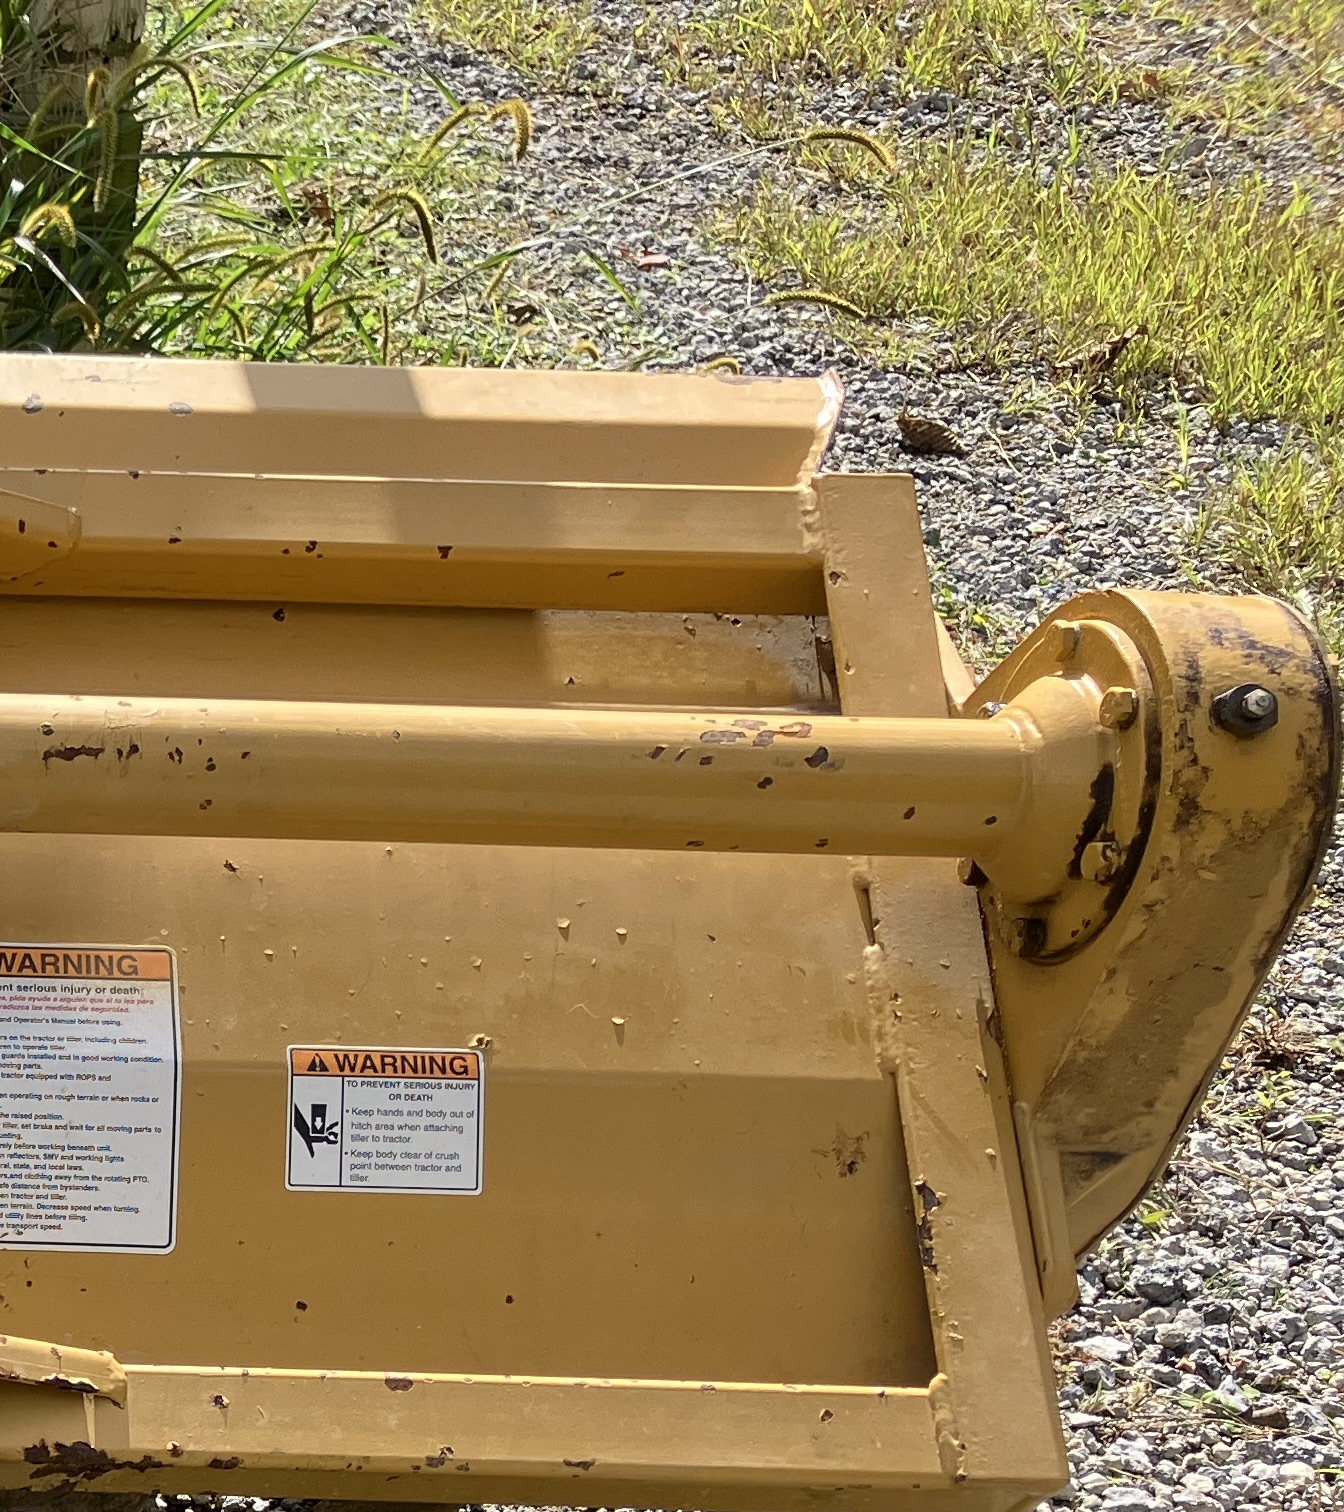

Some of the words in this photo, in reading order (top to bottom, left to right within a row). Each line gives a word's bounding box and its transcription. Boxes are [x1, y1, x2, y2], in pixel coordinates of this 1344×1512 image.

[17, 984, 57, 992] serious
[61, 985, 91, 994] injury
[334, 1054, 468, 1076] WARNING
[352, 1107, 374, 1117] Keep
[377, 1108, 404, 1117] hands
[407, 1109, 423, 1117] and
[426, 1109, 447, 1120] body
[466, 1110, 474, 1118] of
[351, 1122, 372, 1130] hitch
[424, 1124, 463, 1134] attaching
[351, 1150, 373, 1159] Keep
[376, 1151, 397, 1160] body
[400, 1151, 422, 1159] clear
[424, 1151, 433, 1159] of
[435, 1152, 459, 1160] crush
[350, 1163, 372, 1171] point
[375, 1162, 411, 1170] between
[445, 1164, 461, 1172] and
